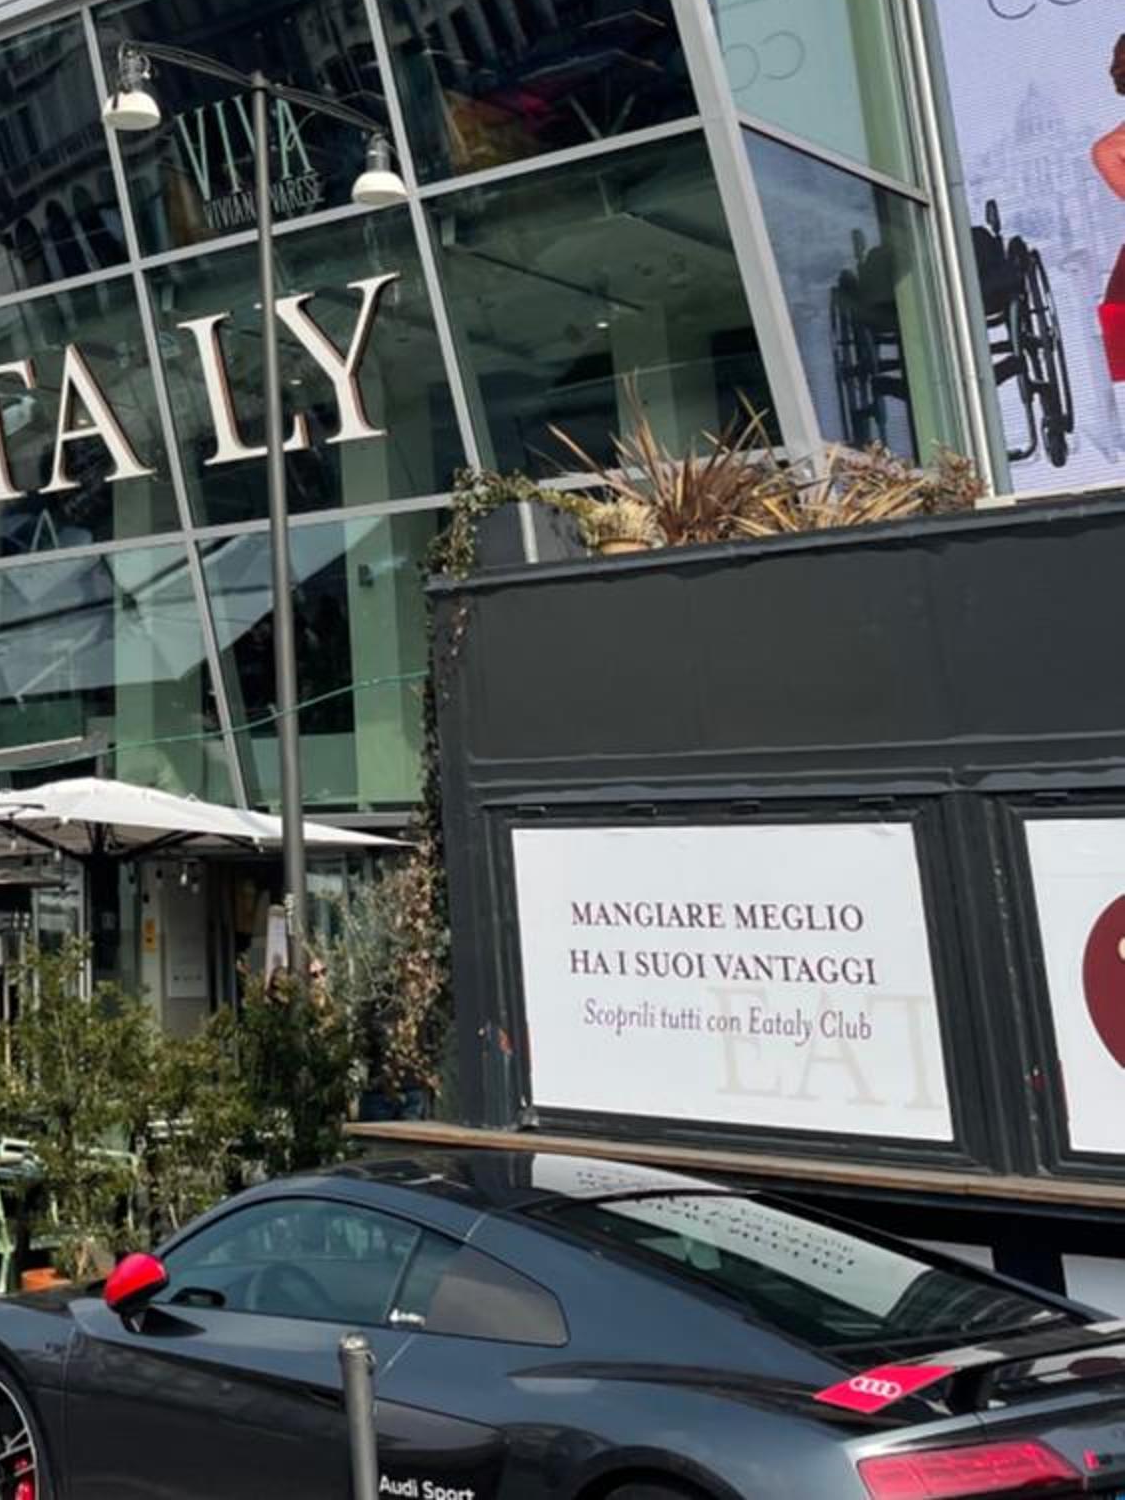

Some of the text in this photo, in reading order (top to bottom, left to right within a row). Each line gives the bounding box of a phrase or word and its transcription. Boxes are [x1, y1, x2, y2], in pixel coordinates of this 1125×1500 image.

[175, 94, 316, 201] VIVA
[203, 190, 258, 230] VIVIAN
[571, 901, 864, 932] MANGIARE MEGLIO
[570, 950, 879, 986] HA I SUOI VANTAGGI
[583, 997, 873, 1048] Scoprili tutti con Eataly Club
[378, 1474, 476, 1500] Audi Sport
